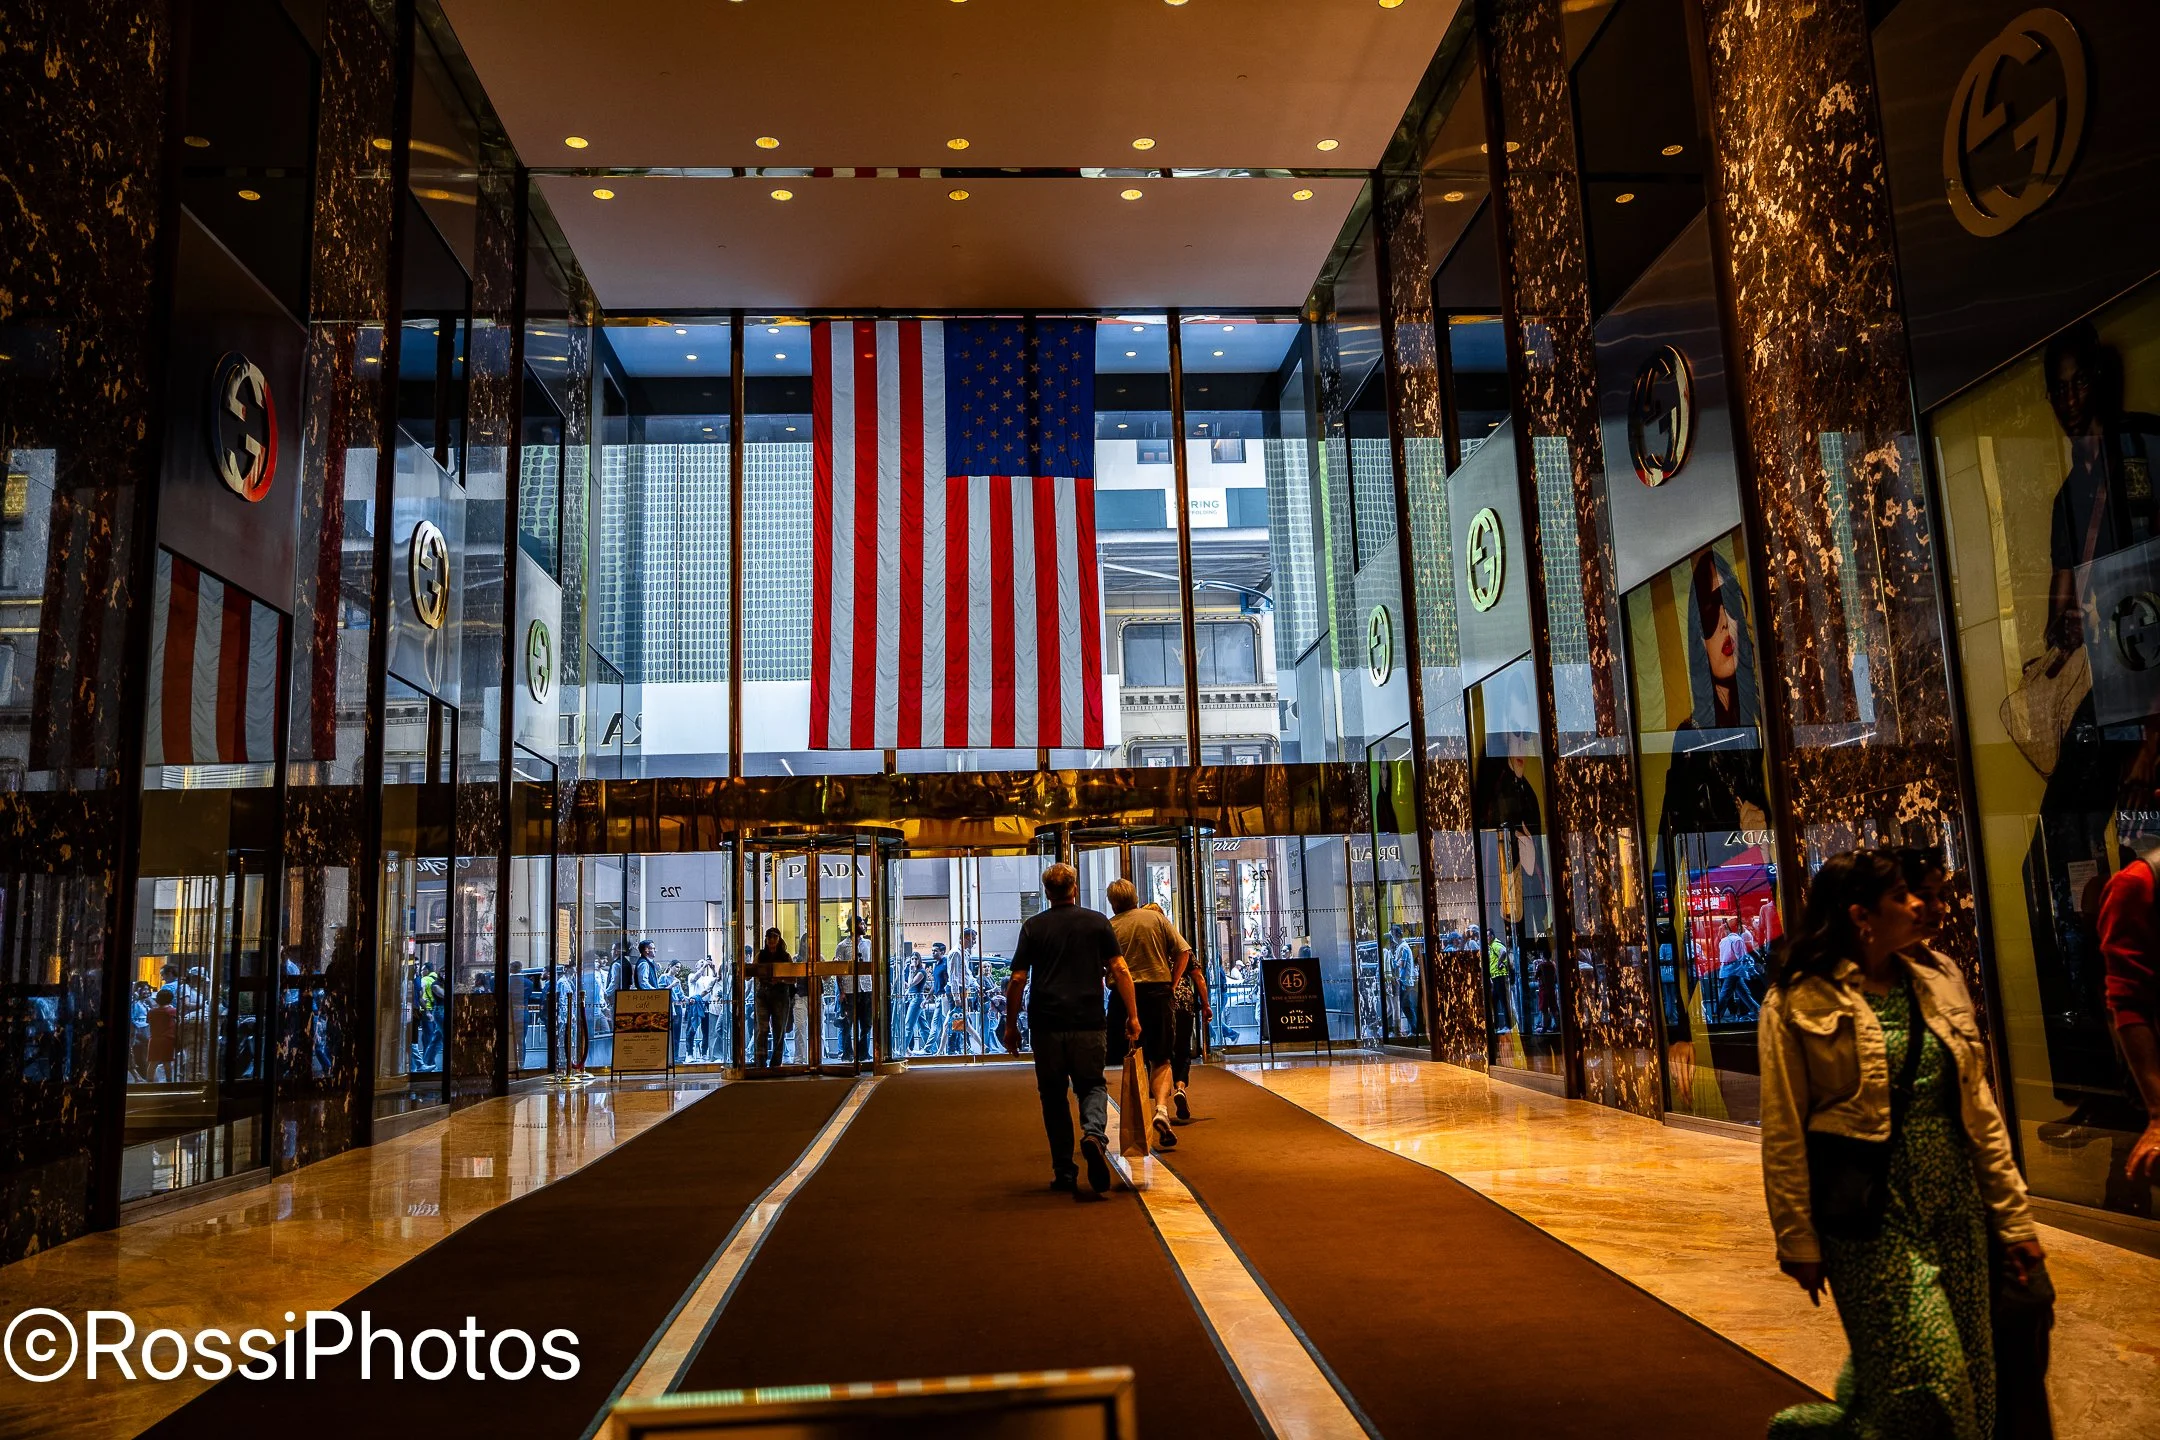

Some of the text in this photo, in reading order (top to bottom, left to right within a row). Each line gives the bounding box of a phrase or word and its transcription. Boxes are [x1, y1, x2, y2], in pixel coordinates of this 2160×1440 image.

[1174, 500, 1219, 509] RING
[2115, 811, 2160, 821] KIMO
[787, 863, 866, 879] PADA
[1282, 973, 1303, 988] 45
[1280, 1014, 1313, 1025] OPEN
